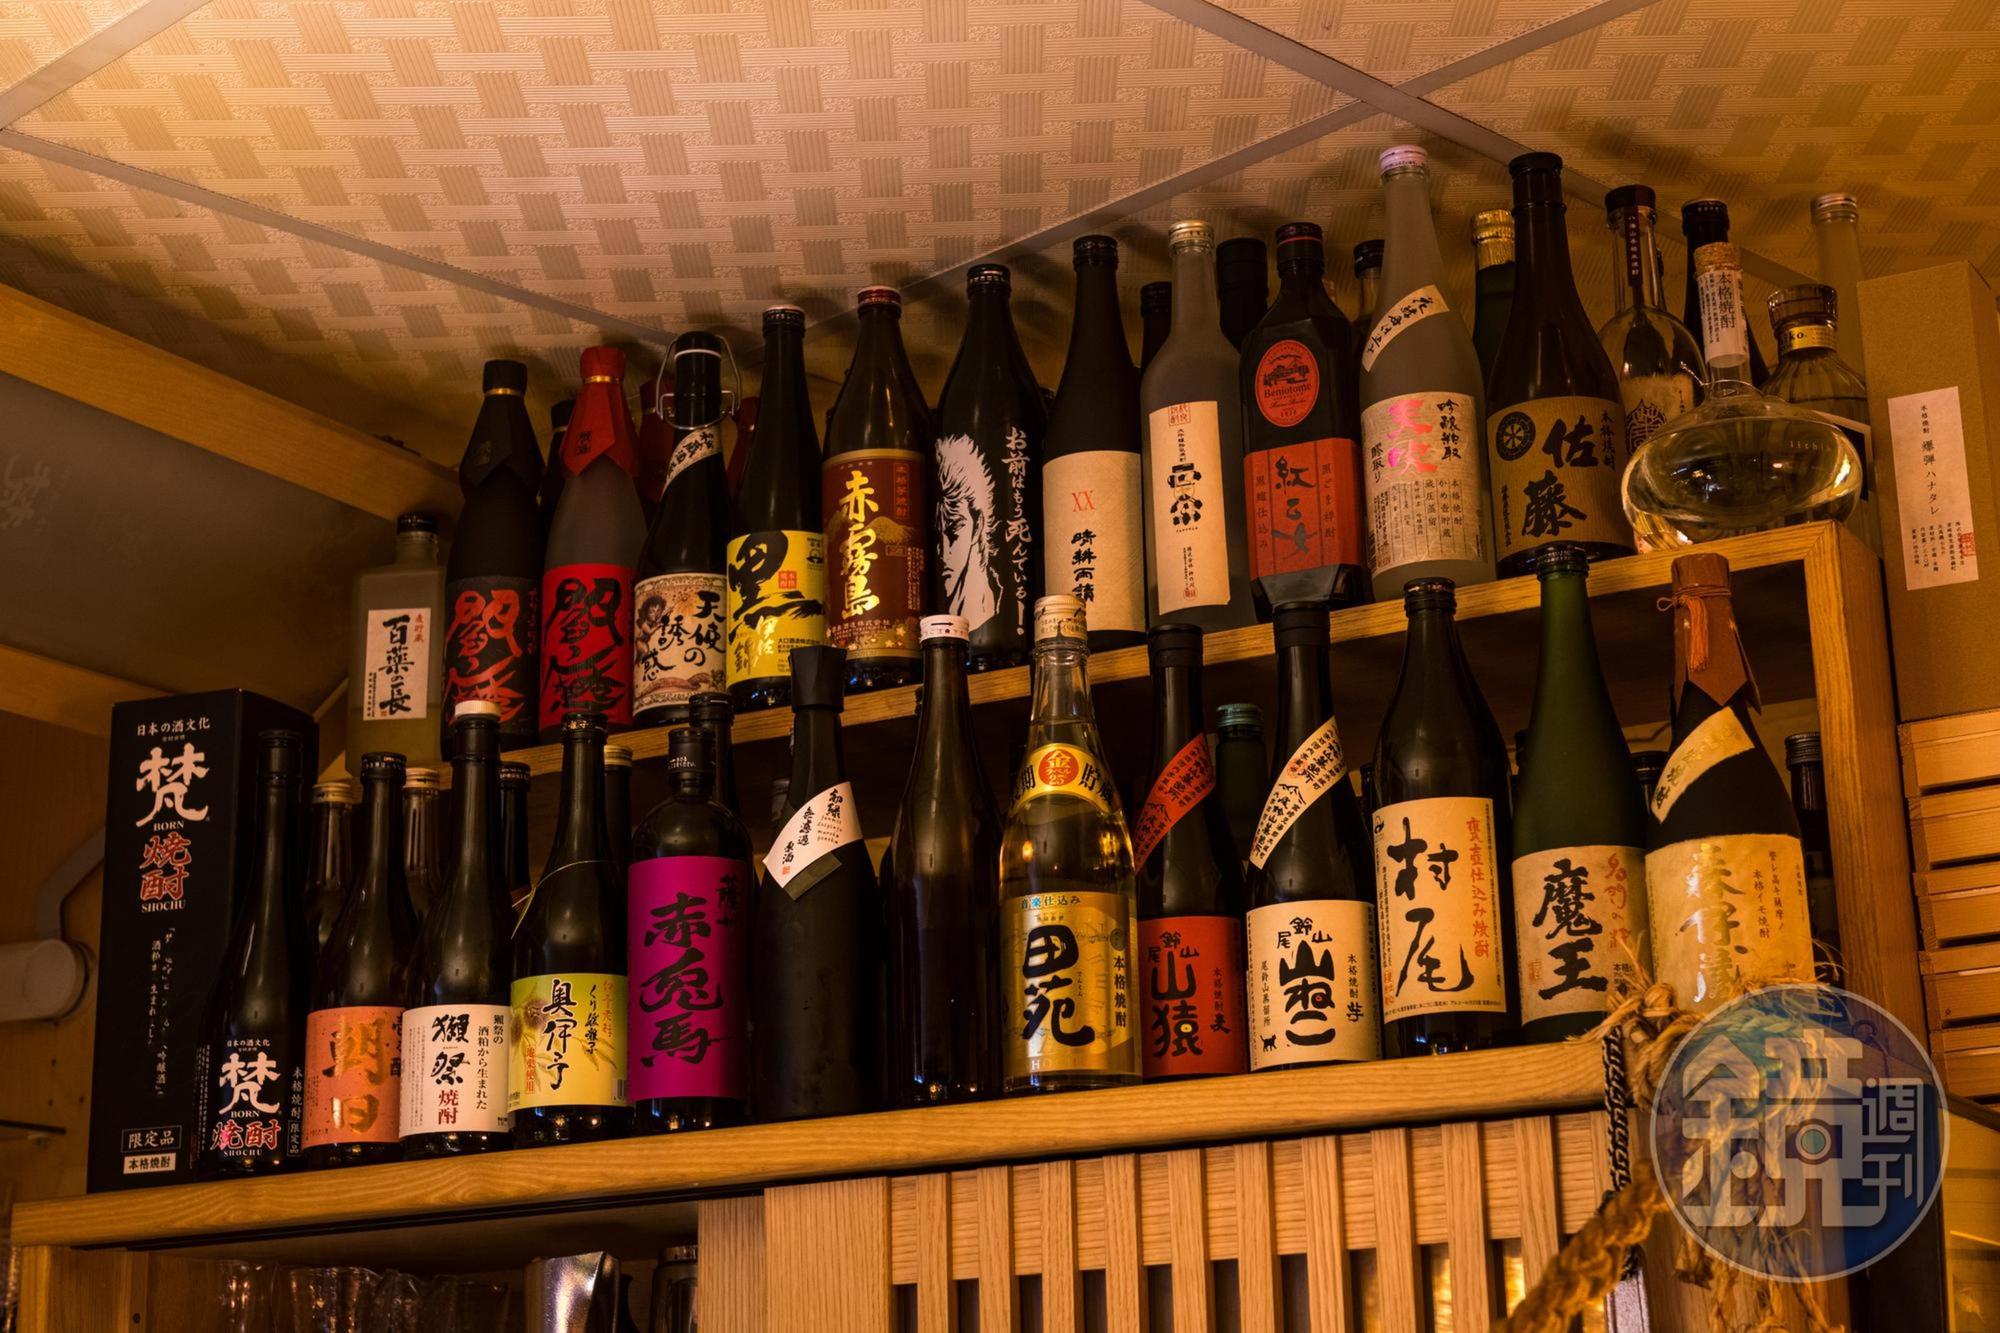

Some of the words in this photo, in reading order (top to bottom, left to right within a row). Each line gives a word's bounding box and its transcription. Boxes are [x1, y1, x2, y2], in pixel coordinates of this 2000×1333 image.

[1719, 271, 1735, 328] 本格焼酎
[1263, 383, 1312, 399] Beniotome
[1522, 415, 1598, 537] 佐藤
[1921, 440, 1940, 516] 爆弾ハナタレ
[839, 470, 880, 619] 赤霧島
[378, 615, 414, 715] 百薬の長
[136, 717, 211, 737] 日本の酒文化
[1047, 750, 1072, 767] 金
[136, 742, 210, 828] 梵
[154, 821, 184, 831] BORN
[139, 831, 192, 900] 焼酎
[141, 900, 186, 913] SHOCHU
[1021, 895, 1080, 909] 音楽仕込み
[1387, 817, 1474, 997] 村尾
[1753, 869, 1770, 939] 本格イモ焼酎
[1149, 931, 1199, 962] 尾鈴山
[1277, 917, 1332, 948] 尾鈴山
[1532, 858, 1608, 1000] 魔王
[1023, 925, 1095, 1046] 田苑
[1113, 956, 1126, 1027] 本格焼酎
[1214, 968, 1223, 1010] 本格焼酎
[1348, 954, 1358, 998] 本格焼酎
[1152, 951, 1203, 1057] 山猿
[1211, 1014, 1231, 1034] 麦
[1346, 1001, 1364, 1022] 芋
[227, 1039, 270, 1048] 日本の酒文化
[431, 1014, 470, 1085] 獺祭
[493, 1015, 504, 1044] 獺祭の
[543, 979, 577, 1089] 奥伊予
[219, 1051, 281, 1115] 梵
[476, 1026, 489, 1110] 酒粕から生まれた
[291, 1066, 303, 1118] 本格焼酎
[438, 1090, 458, 1124] 焼酎
[210, 1119, 282, 1150] 焼酎
[230, 1110, 260, 1118] BORN
[128, 1130, 174, 1148] 限定品
[223, 1149, 262, 1157] SHOCHU
[129, 1158, 171, 1170] 本格焼酎
